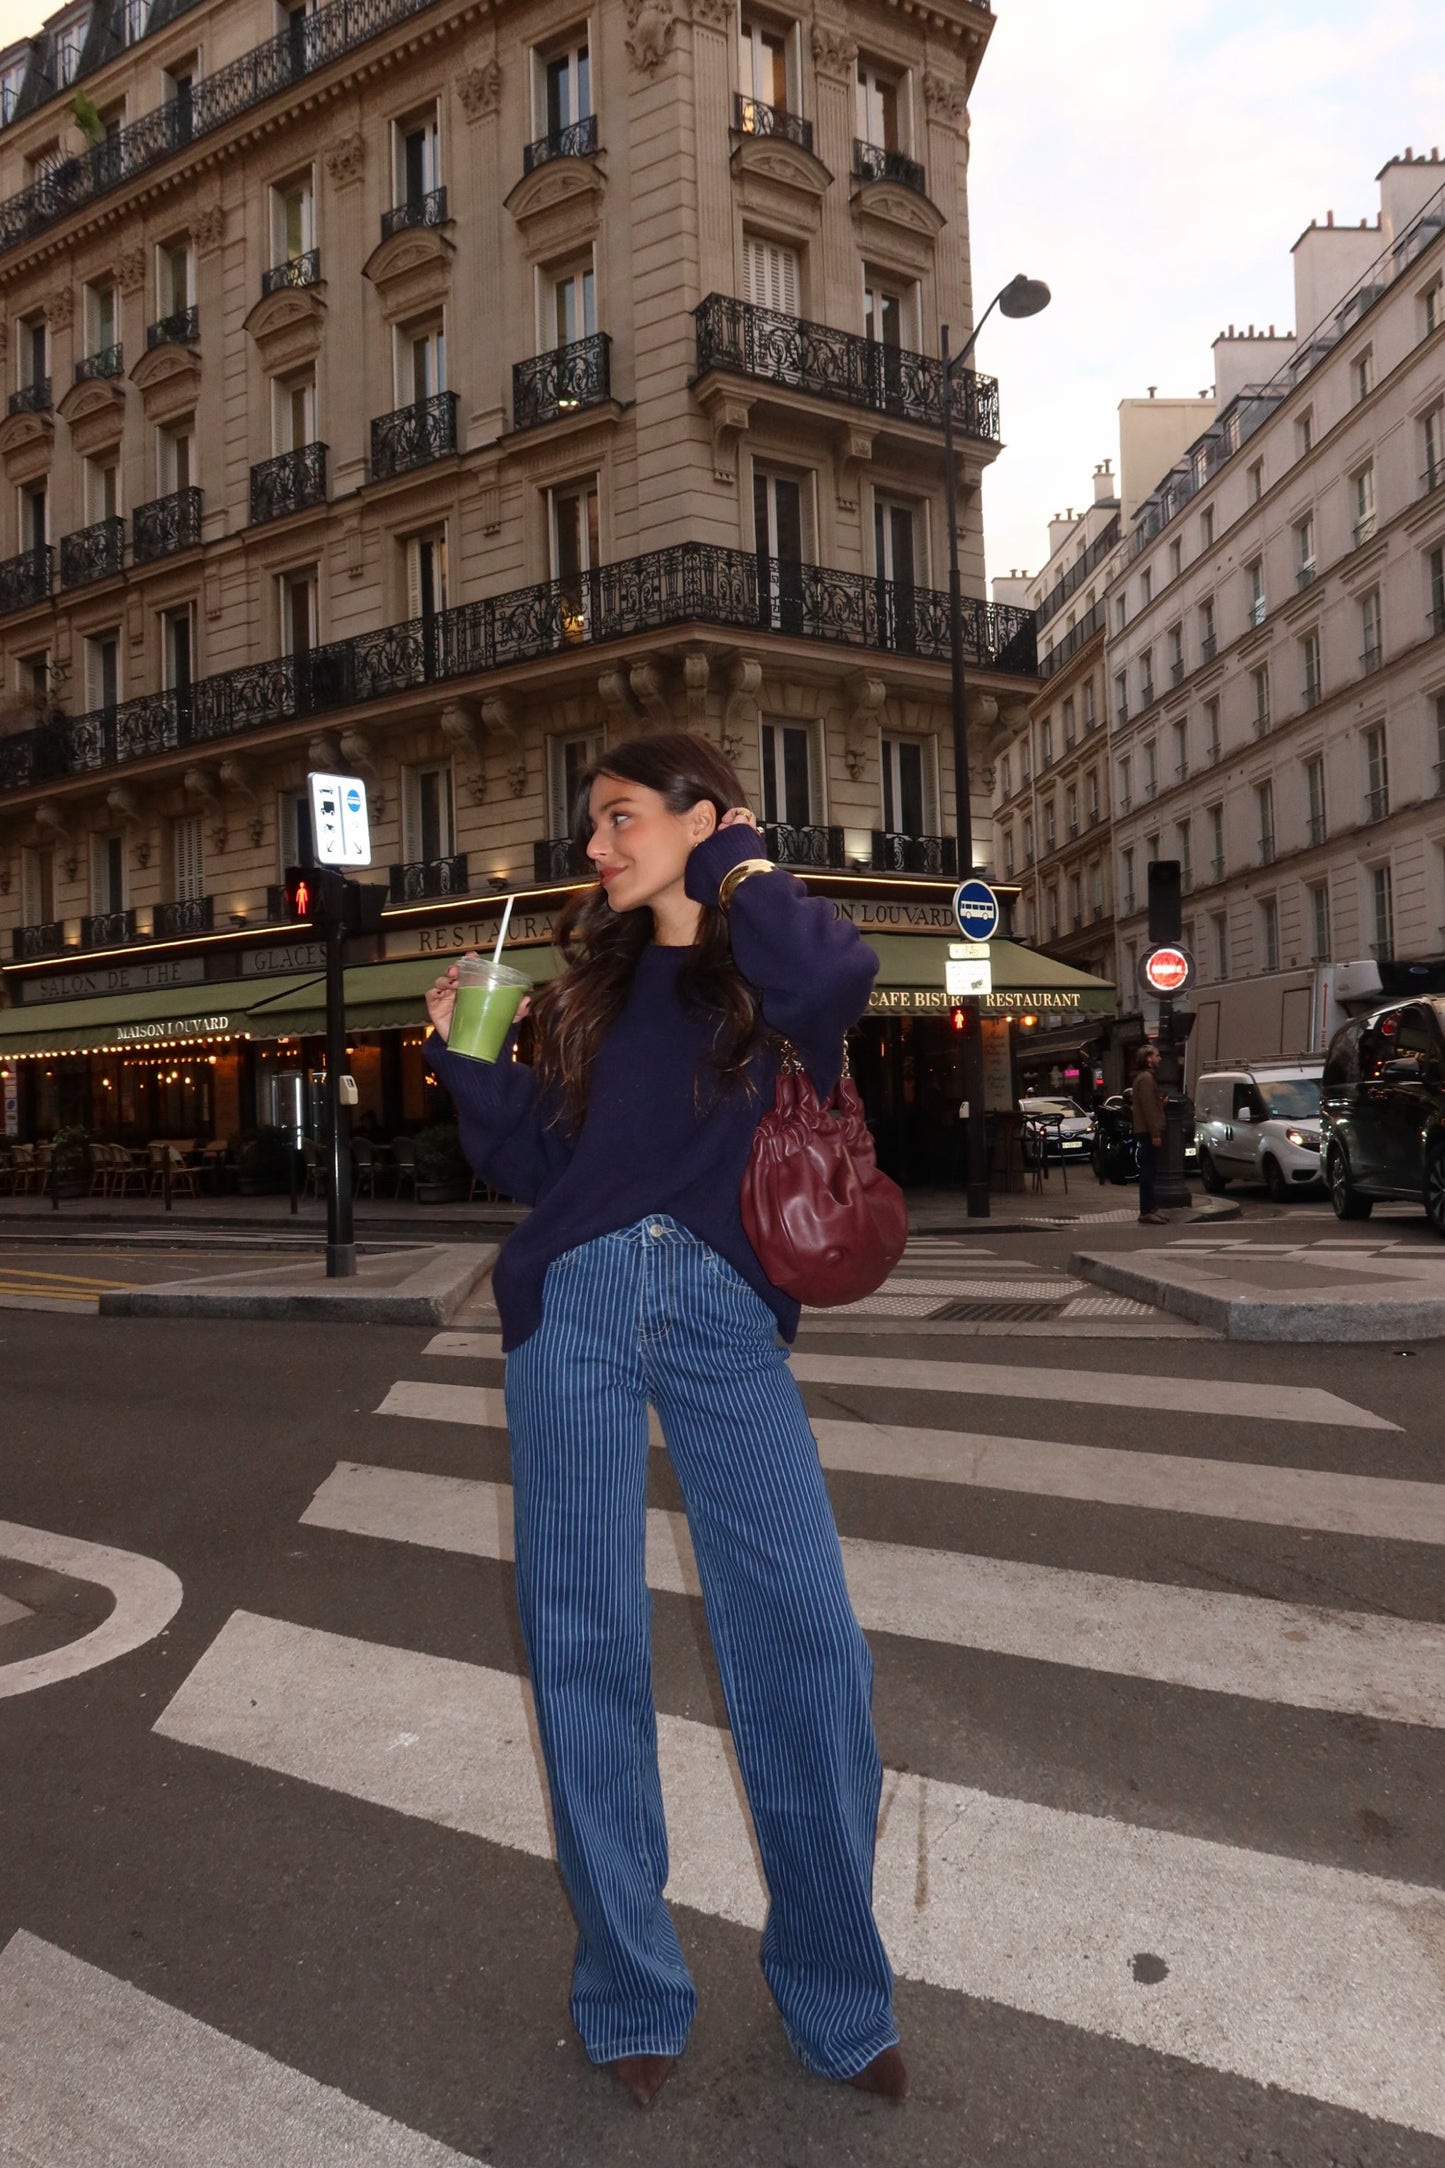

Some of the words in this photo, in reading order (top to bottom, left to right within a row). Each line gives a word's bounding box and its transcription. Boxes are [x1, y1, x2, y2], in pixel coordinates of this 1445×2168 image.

[862, 904, 955, 927] LOUVARD
[419, 915, 554, 951] RESTAURA
[254, 944, 328, 971] GLACES
[40, 974, 97, 998] SALON
[108, 970, 130, 990] DE
[914, 992, 980, 1007] BISTR
[985, 992, 1081, 1007] RESTAURANT
[117, 1023, 165, 1040] MAISON
[166, 1016, 229, 1035] LOUVARD
